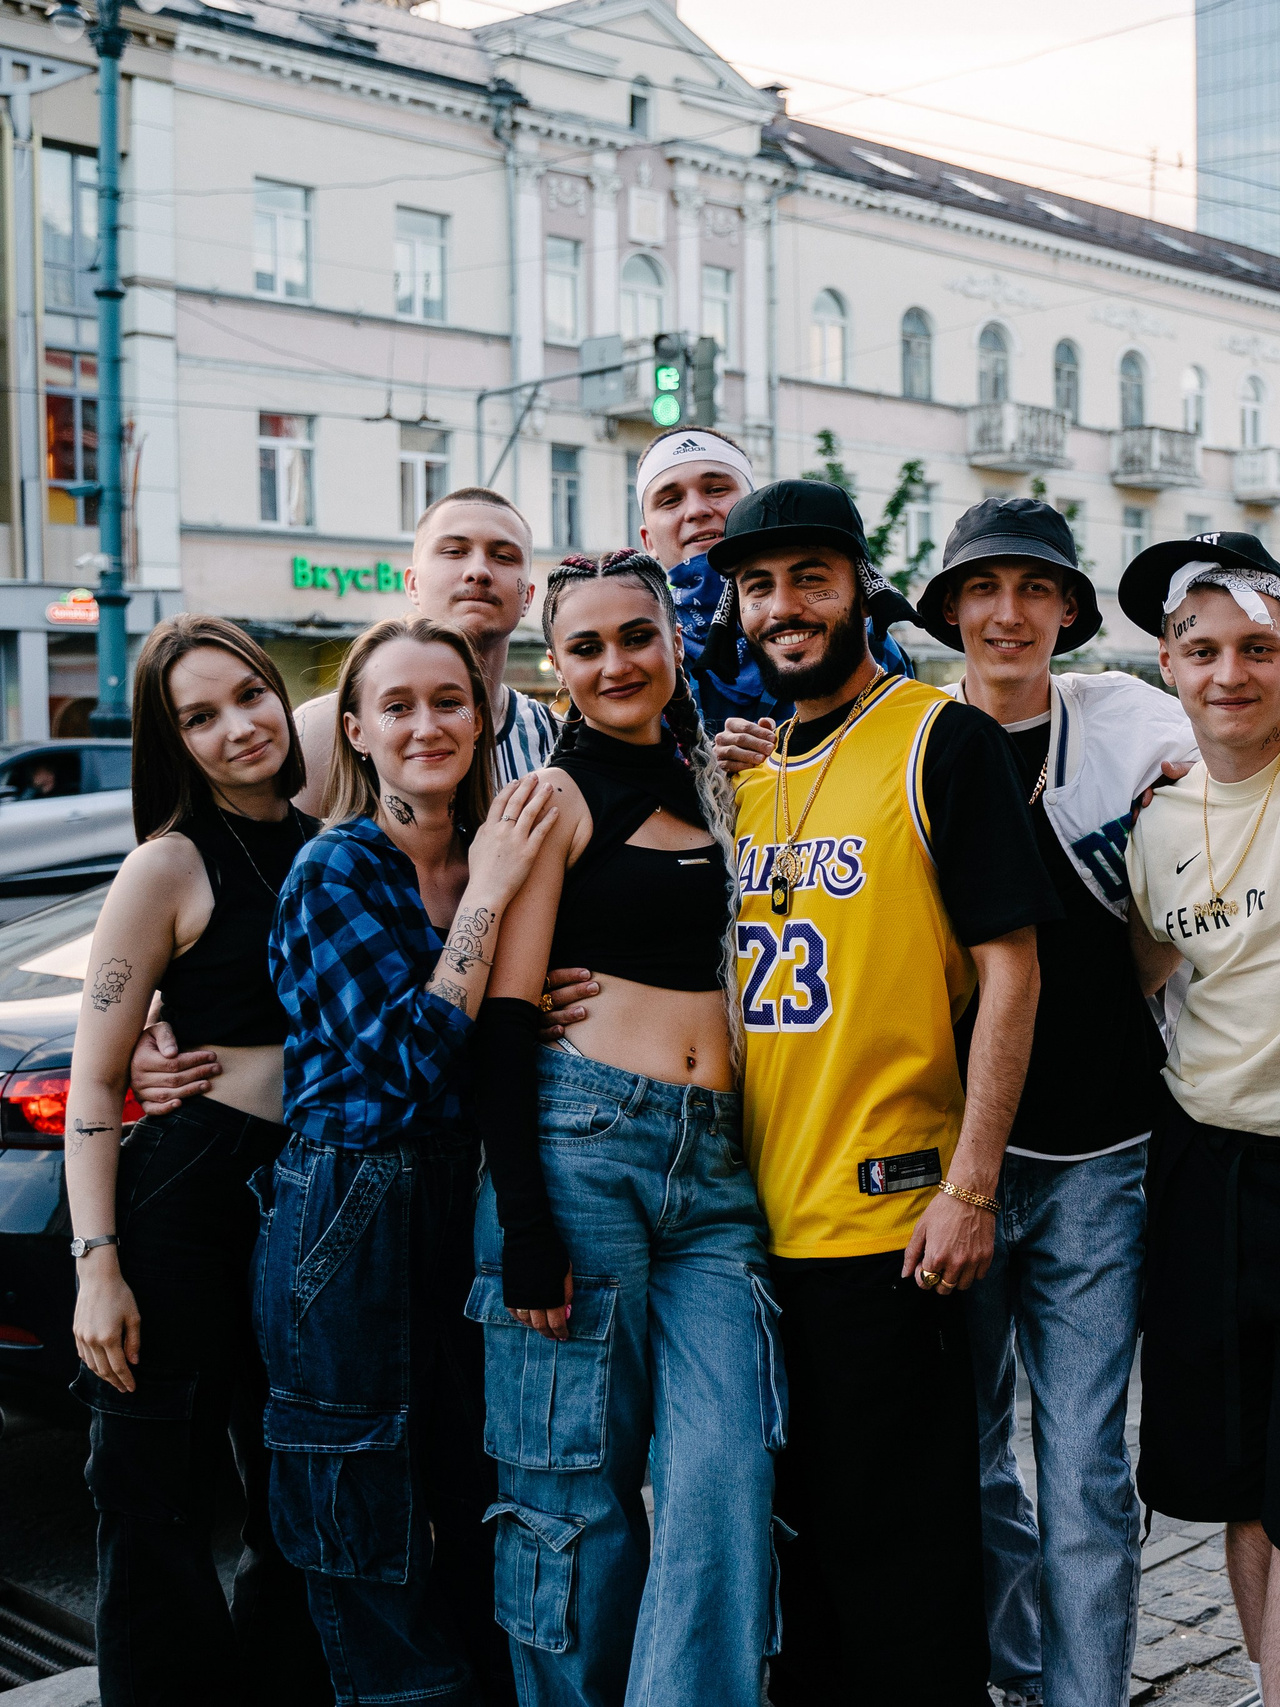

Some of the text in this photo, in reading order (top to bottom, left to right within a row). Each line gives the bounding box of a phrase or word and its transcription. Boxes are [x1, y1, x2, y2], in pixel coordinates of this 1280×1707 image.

[672, 446, 707, 456] adidas
[1173, 614, 1198, 640] love
[736, 834, 867, 900] LAERS
[736, 918, 834, 1033] 23
